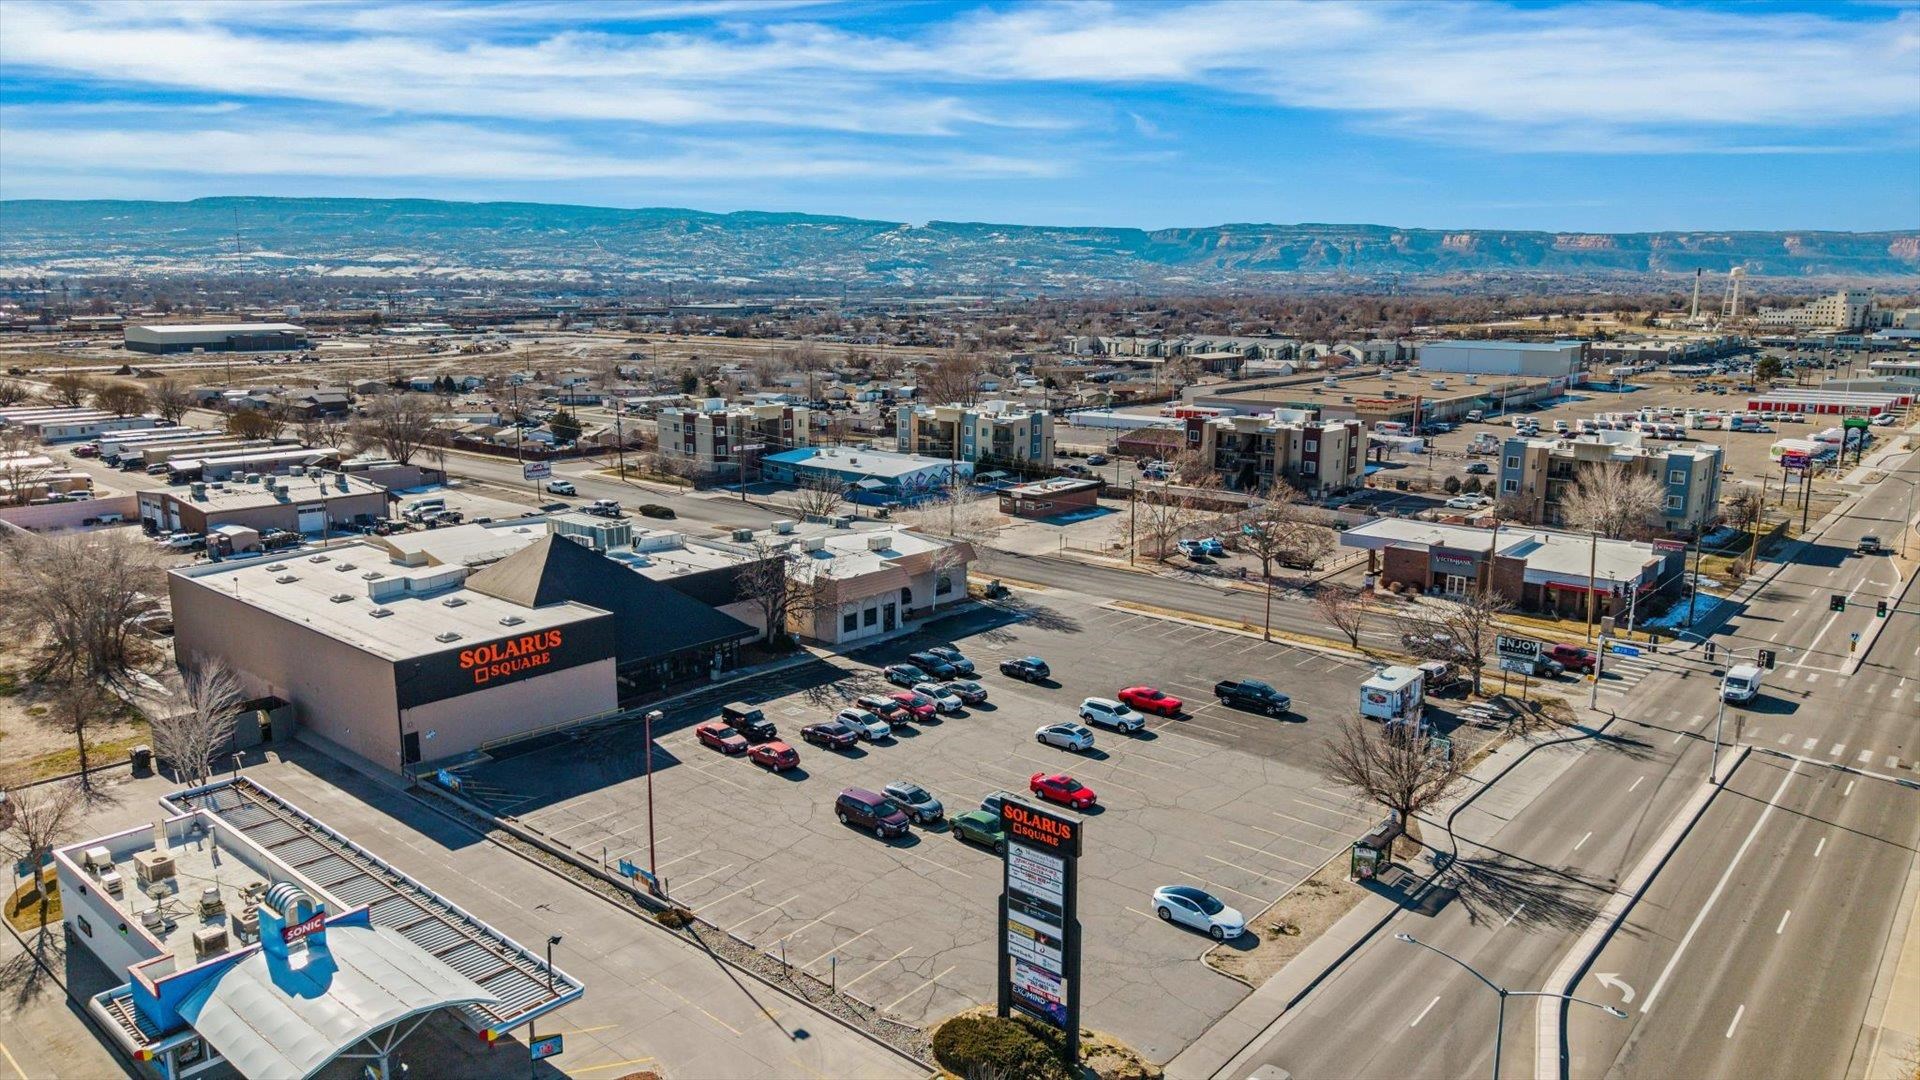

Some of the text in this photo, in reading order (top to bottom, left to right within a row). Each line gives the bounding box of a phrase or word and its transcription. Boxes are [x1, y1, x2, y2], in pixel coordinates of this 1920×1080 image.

[460, 630, 562, 668] SOLARUS
[1499, 636, 1537, 651] ENJOY
[491, 652, 550, 676] SQUARE
[1004, 804, 1071, 839] SOLARUS
[1022, 826, 1059, 847] SQUARE
[287, 918, 322, 940] SONIC
